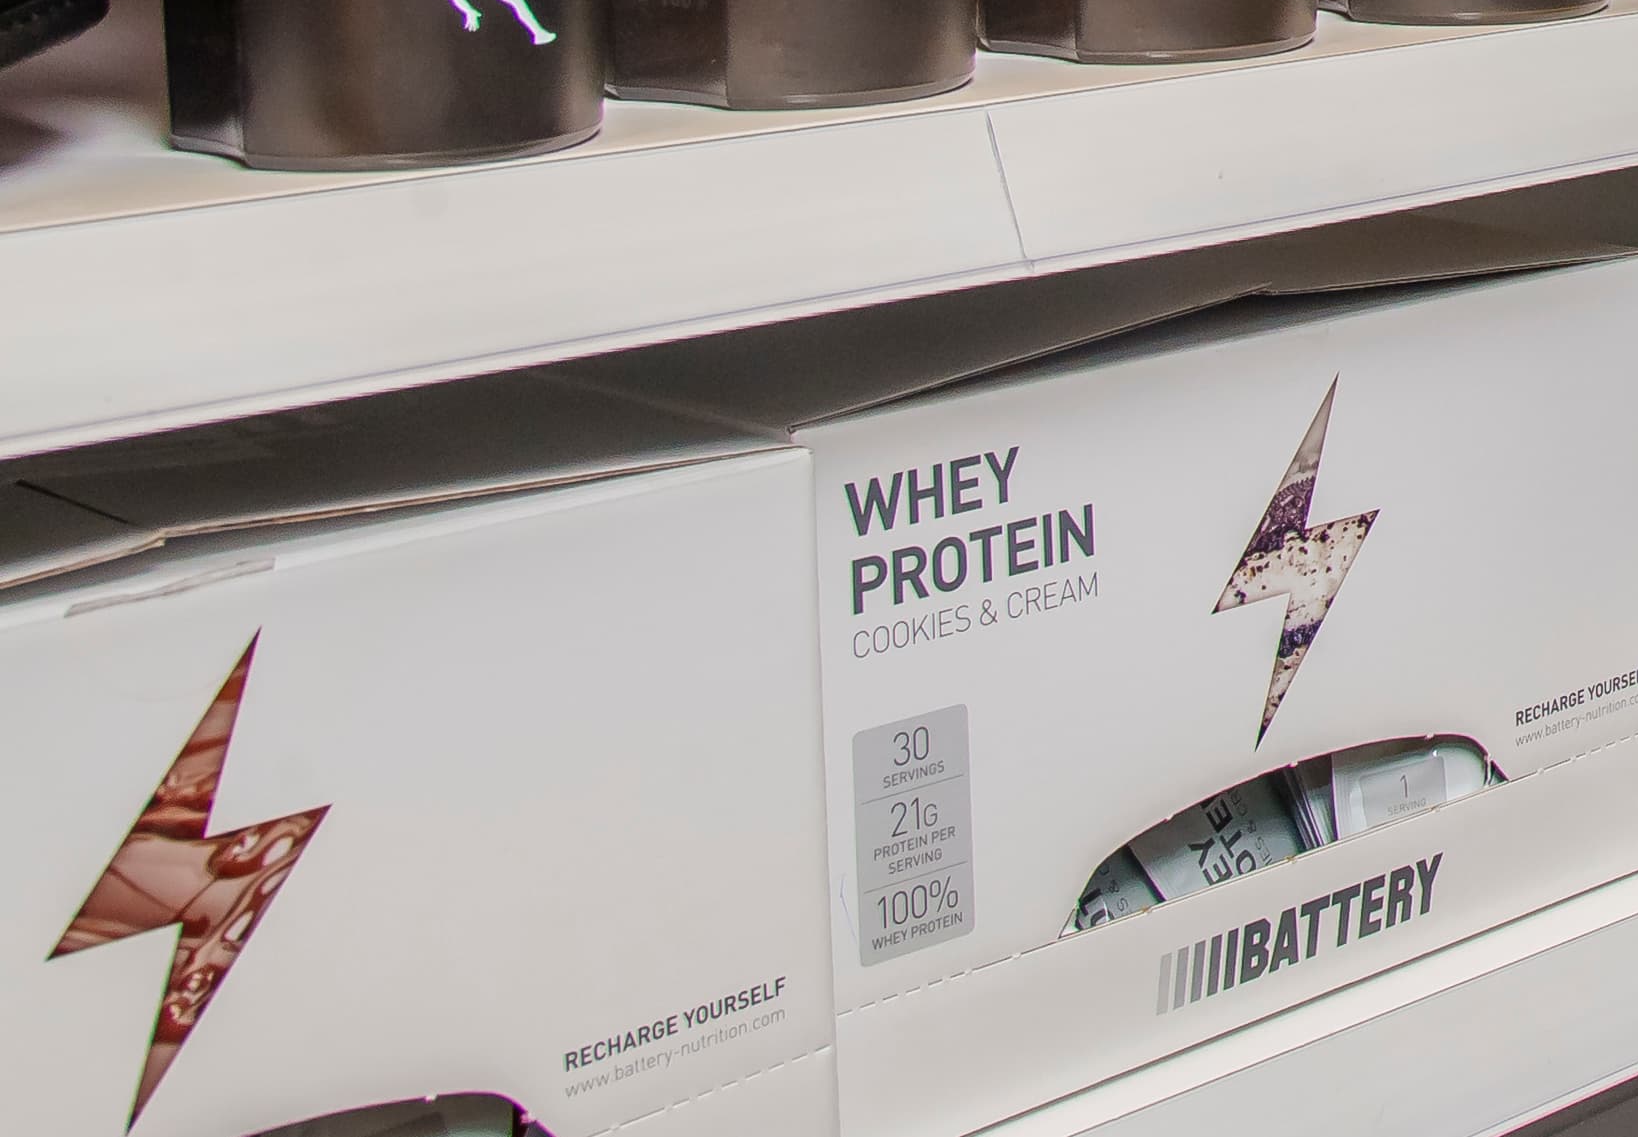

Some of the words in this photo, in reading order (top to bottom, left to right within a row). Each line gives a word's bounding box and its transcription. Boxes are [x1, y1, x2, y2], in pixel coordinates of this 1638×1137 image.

[845, 446, 1020, 536] WHEY
[851, 503, 1095, 615] PROTEIN
[853, 604, 971, 658] COOKIES
[979, 598, 998, 626] &
[1007, 571, 1099, 619] CREAM
[1515, 689, 1585, 726] RECHARGE
[893, 726, 930, 766] 30
[883, 760, 945, 789] SERVINGS
[1400, 774, 1408, 798] 1
[891, 797, 938, 838] 21G
[1387, 798, 1427, 817] SERVING
[874, 834, 928, 861] PROTEIN
[931, 825, 956, 845] PER
[888, 848, 943, 874] SERVING
[877, 876, 958, 928] 100%
[1240, 852, 1443, 985] BATTERY
[872, 928, 908, 950] WHEY
[911, 912, 963, 938] PROTEIN
[563, 1015, 680, 1072] RECHARGE
[683, 976, 788, 1031] YOURSELF
[564, 1006, 787, 1099] www.battery-nutrition.com
